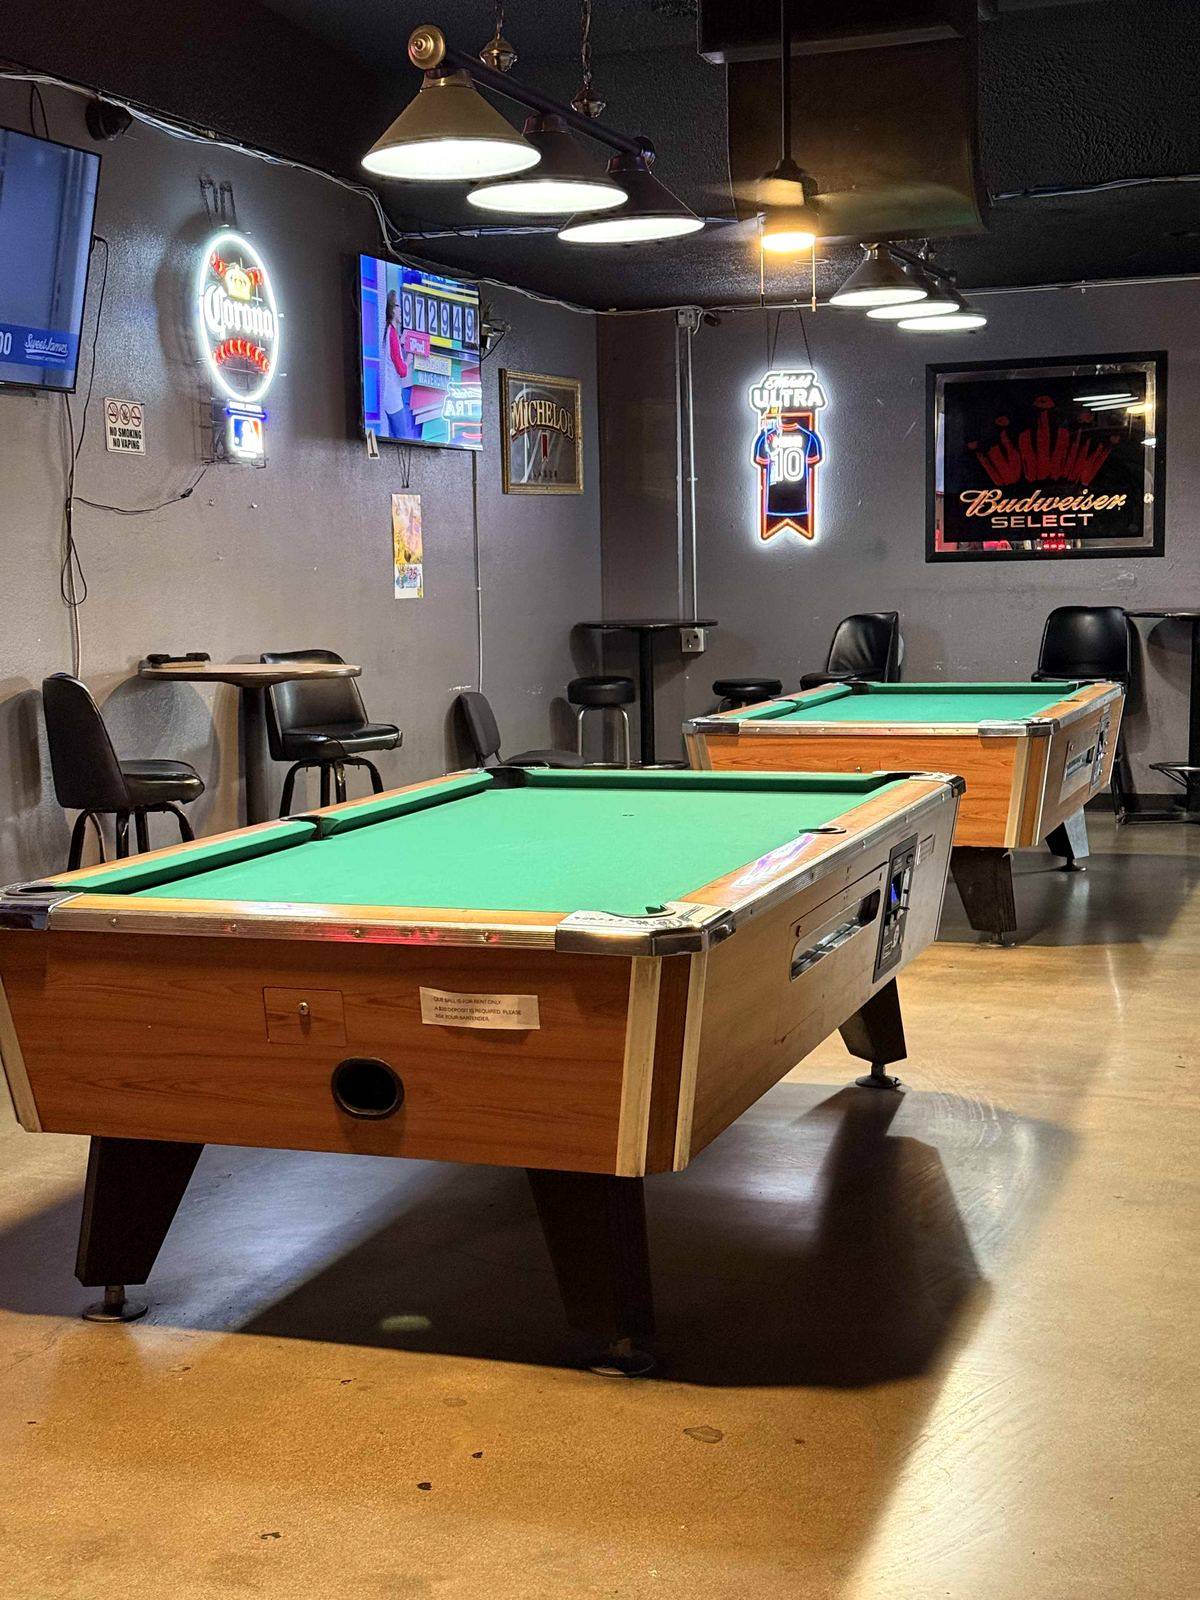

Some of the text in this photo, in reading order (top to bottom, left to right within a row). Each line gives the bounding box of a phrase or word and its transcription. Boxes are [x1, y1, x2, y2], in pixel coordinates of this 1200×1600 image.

[203, 284, 274, 340] Corona
[753, 386, 824, 408] ULTRA
[109, 427, 142, 440] NO SMOKING
[112, 438, 140, 450] NO VAPING
[774, 447, 805, 482] 10
[959, 488, 1128, 517] Budweiser
[991, 513, 1094, 529] SELECT
